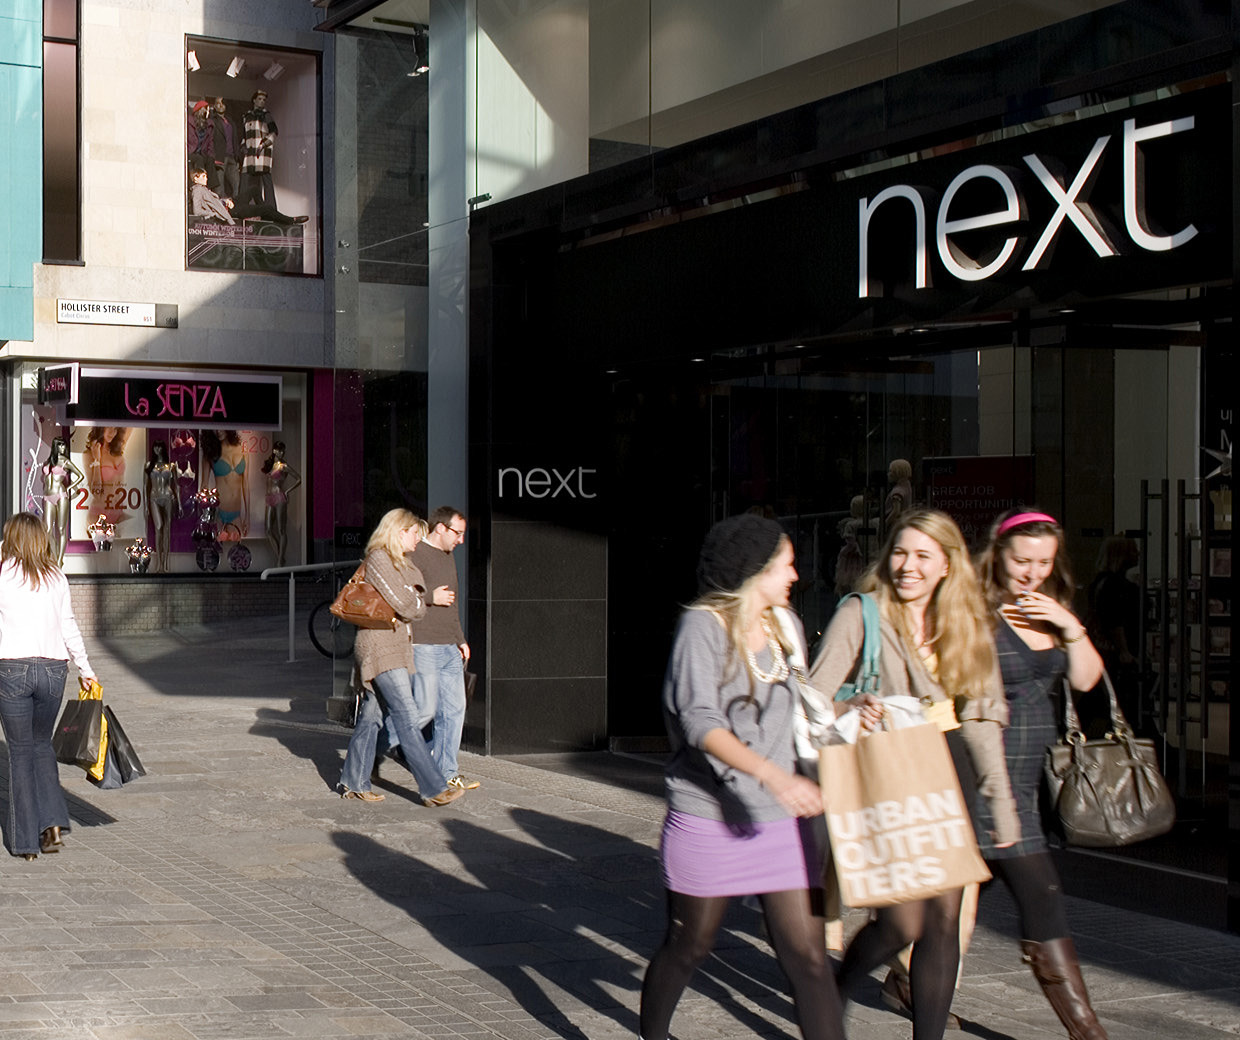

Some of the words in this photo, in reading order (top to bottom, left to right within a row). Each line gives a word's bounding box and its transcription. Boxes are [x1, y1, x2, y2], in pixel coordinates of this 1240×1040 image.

[859, 114, 1199, 299] next
[61, 303, 101, 313] HOLLISTER
[103, 304, 130, 314] STREET
[124, 382, 149, 416] La
[157, 383, 227, 418] SENZA
[104, 487, 141, 510] £20
[498, 467, 598, 500] next
[931, 486, 968, 496] GREAT
[970, 485, 996, 496] JOB
[829, 789, 963, 841] URBAN
[836, 818, 967, 870] OUTFIT
[842, 856, 948, 899] TERS
